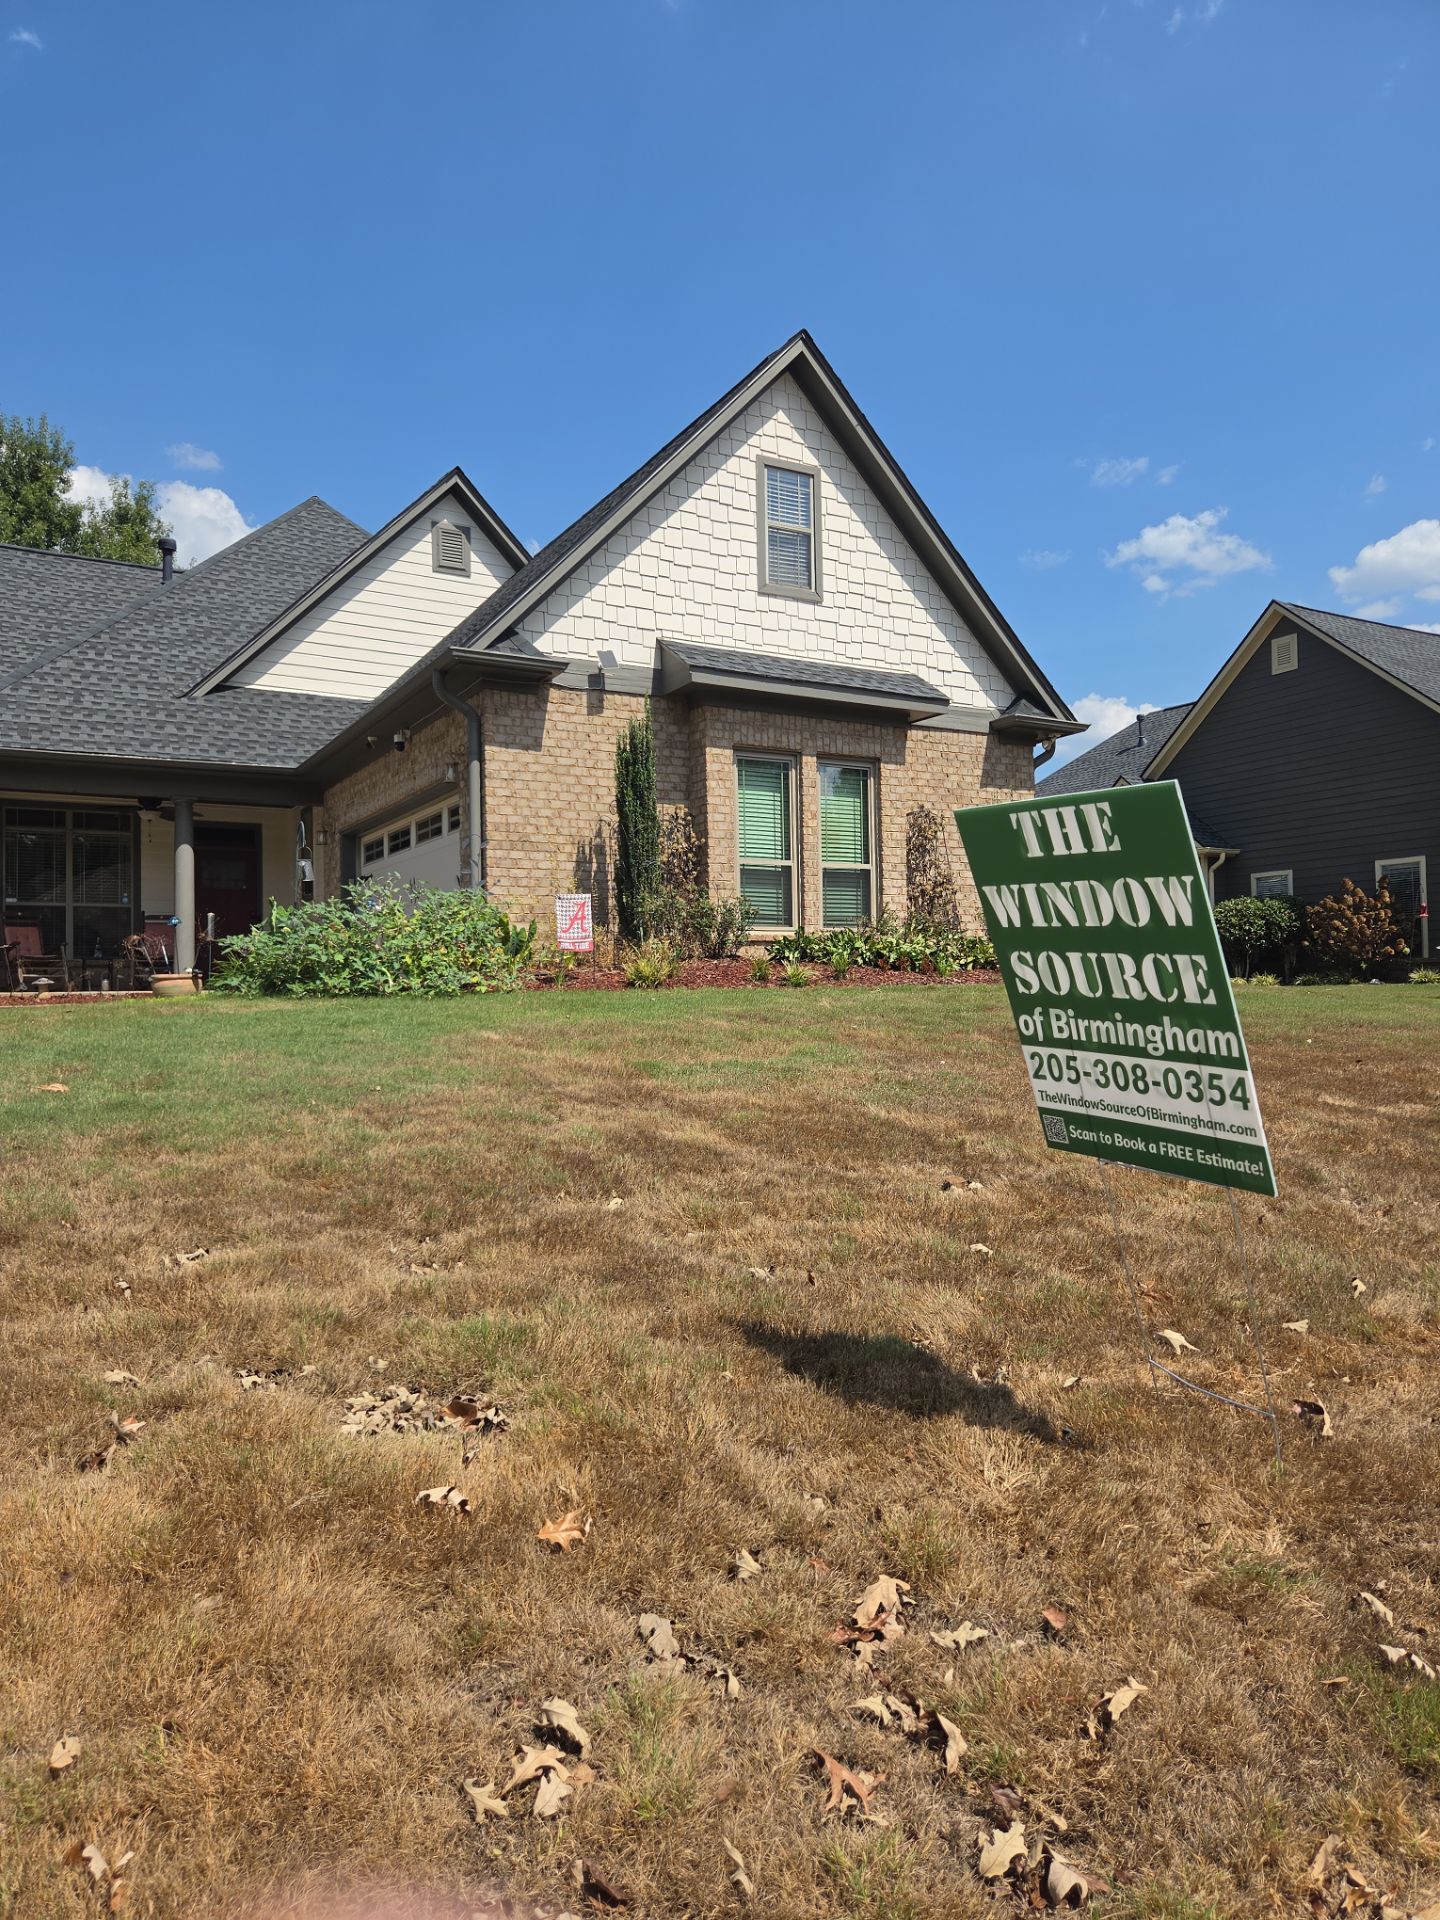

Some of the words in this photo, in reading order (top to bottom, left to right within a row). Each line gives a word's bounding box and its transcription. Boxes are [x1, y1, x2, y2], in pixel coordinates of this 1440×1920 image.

[1009, 801, 1121, 858] THE
[982, 875, 1194, 929] WINDOW
[1010, 950, 1217, 1005] SOURCE
[1018, 1007, 1044, 1041] of
[1048, 1008, 1240, 1058] Birmingham
[1029, 1051, 1251, 1111] 205-308-0354
[1038, 1089, 1258, 1138] TheWindowSourceOfBirmingham.com
[1069, 1125, 1098, 1143] Scan
[1099, 1130, 1112, 1145] to
[1114, 1133, 1147, 1152] Book
[1148, 1143, 1158, 1154] a
[1159, 1142, 1195, 1162] FREE
[1196, 1149, 1265, 1177] Estimate!
